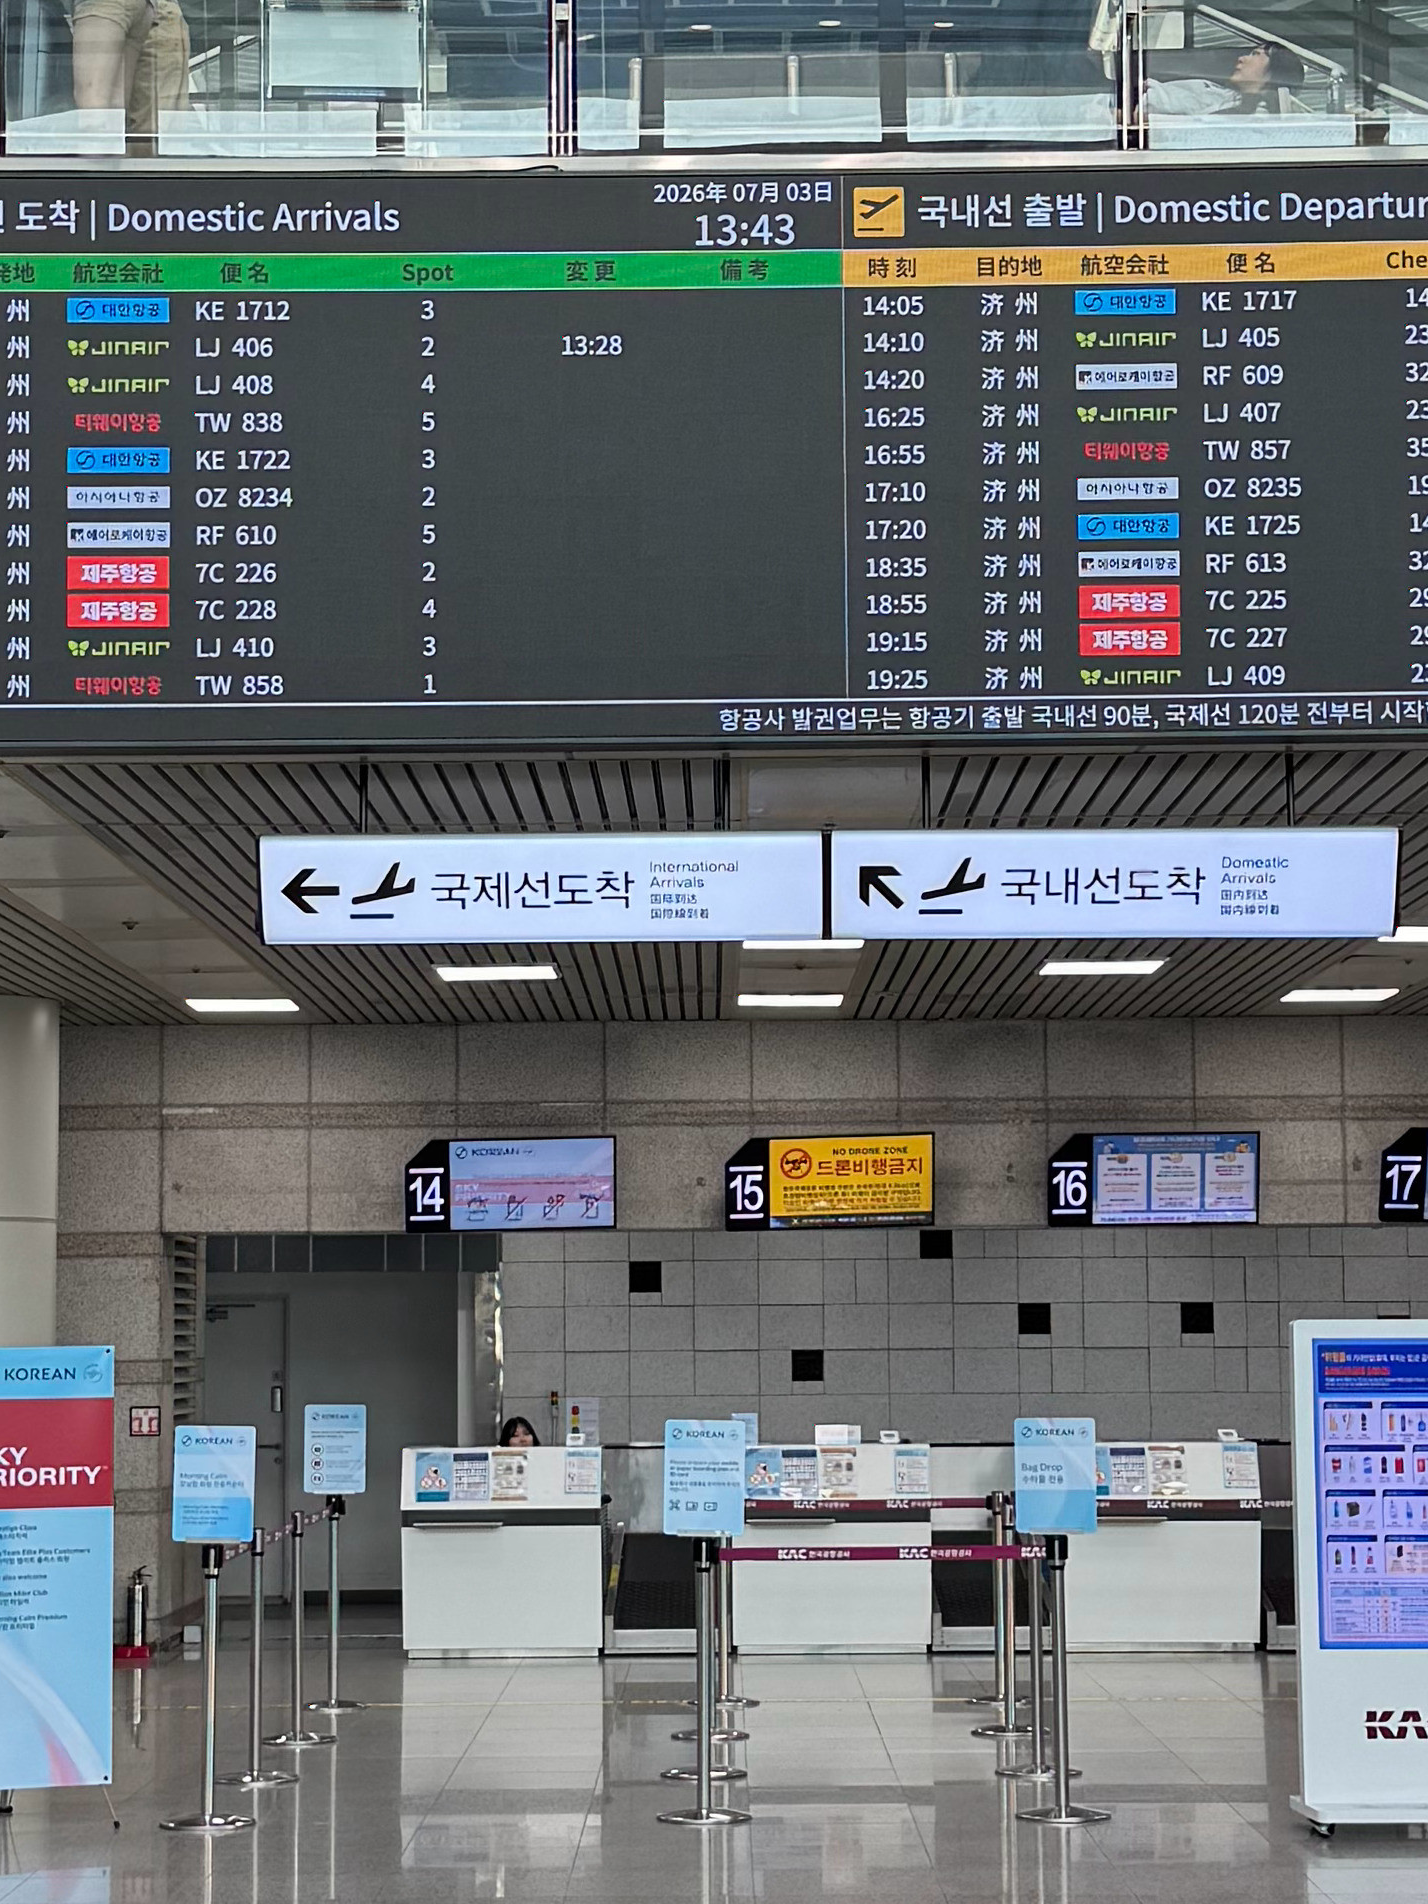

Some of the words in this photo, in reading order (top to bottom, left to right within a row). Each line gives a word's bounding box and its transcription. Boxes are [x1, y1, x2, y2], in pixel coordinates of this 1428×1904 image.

[653, 181, 728, 204] 2026年
[732, 181, 779, 204] 07月
[786, 181, 832, 203] 03日
[15, 199, 81, 235] 도착
[108, 201, 265, 232] Domestic
[271, 200, 400, 232] Arrivals
[917, 193, 1012, 229] 국내선
[1022, 192, 1087, 227] 출발
[1114, 193, 1271, 224] Domestic
[695, 213, 795, 247] 13:43
[73, 261, 165, 285] 航空会社
[219, 261, 269, 284] 便名
[402, 263, 454, 286] Spot
[719, 258, 769, 281] 備考
[868, 256, 917, 279] 時刻
[977, 254, 1043, 278] 目的地
[1080, 253, 1170, 277] 航空会社
[1226, 251, 1275, 274] 便名
[862, 295, 924, 316] 14:05
[980, 291, 1038, 316] 済州
[1201, 291, 1232, 312] KE
[1243, 289, 1297, 311] 1717
[91, 339, 170, 357] JINAIR
[195, 337, 221, 358] LJ
[231, 337, 274, 358] 406
[421, 336, 435, 357] 2
[561, 334, 623, 356] 13:28
[719, 707, 786, 732] 항공사
[791, 706, 903, 731] 발권업무는
[908, 705, 974, 730] 항공기
[981, 704, 1026, 729] 출발
[1031, 704, 1097, 729] 국내선
[1103, 703, 1159, 730] 90분,
[1164, 702, 1231, 727] 국제선
[1238, 702, 1301, 726] 120분
[1307, 700, 1373, 725] 전부터
[649, 860, 739, 873] International
[1221, 855, 1289, 869] Domestic
[430, 870, 635, 910] 국제선도착
[649, 876, 705, 889] Arrivals
[1000, 866, 1206, 906] 국내선도착
[1220, 872, 1277, 884] Arrivals
[814, 1155, 926, 1179] 드론비행금지
[728, 1173, 765, 1211] 15
[1051, 1168, 1088, 1208] 16
[1386, 1164, 1422, 1202] 17
[407, 1183, 446, 1215] 14
[4, 1367, 77, 1381] KOREAN
[194, 1436, 234, 1446] KOREAN
[685, 1429, 725, 1439] KOREAN
[1035, 1428, 1075, 1437] KOREAN
[1021, 1462, 1037, 1474] Bag
[1039, 1462, 1063, 1474] Drop
[777, 1548, 807, 1560] KAC
